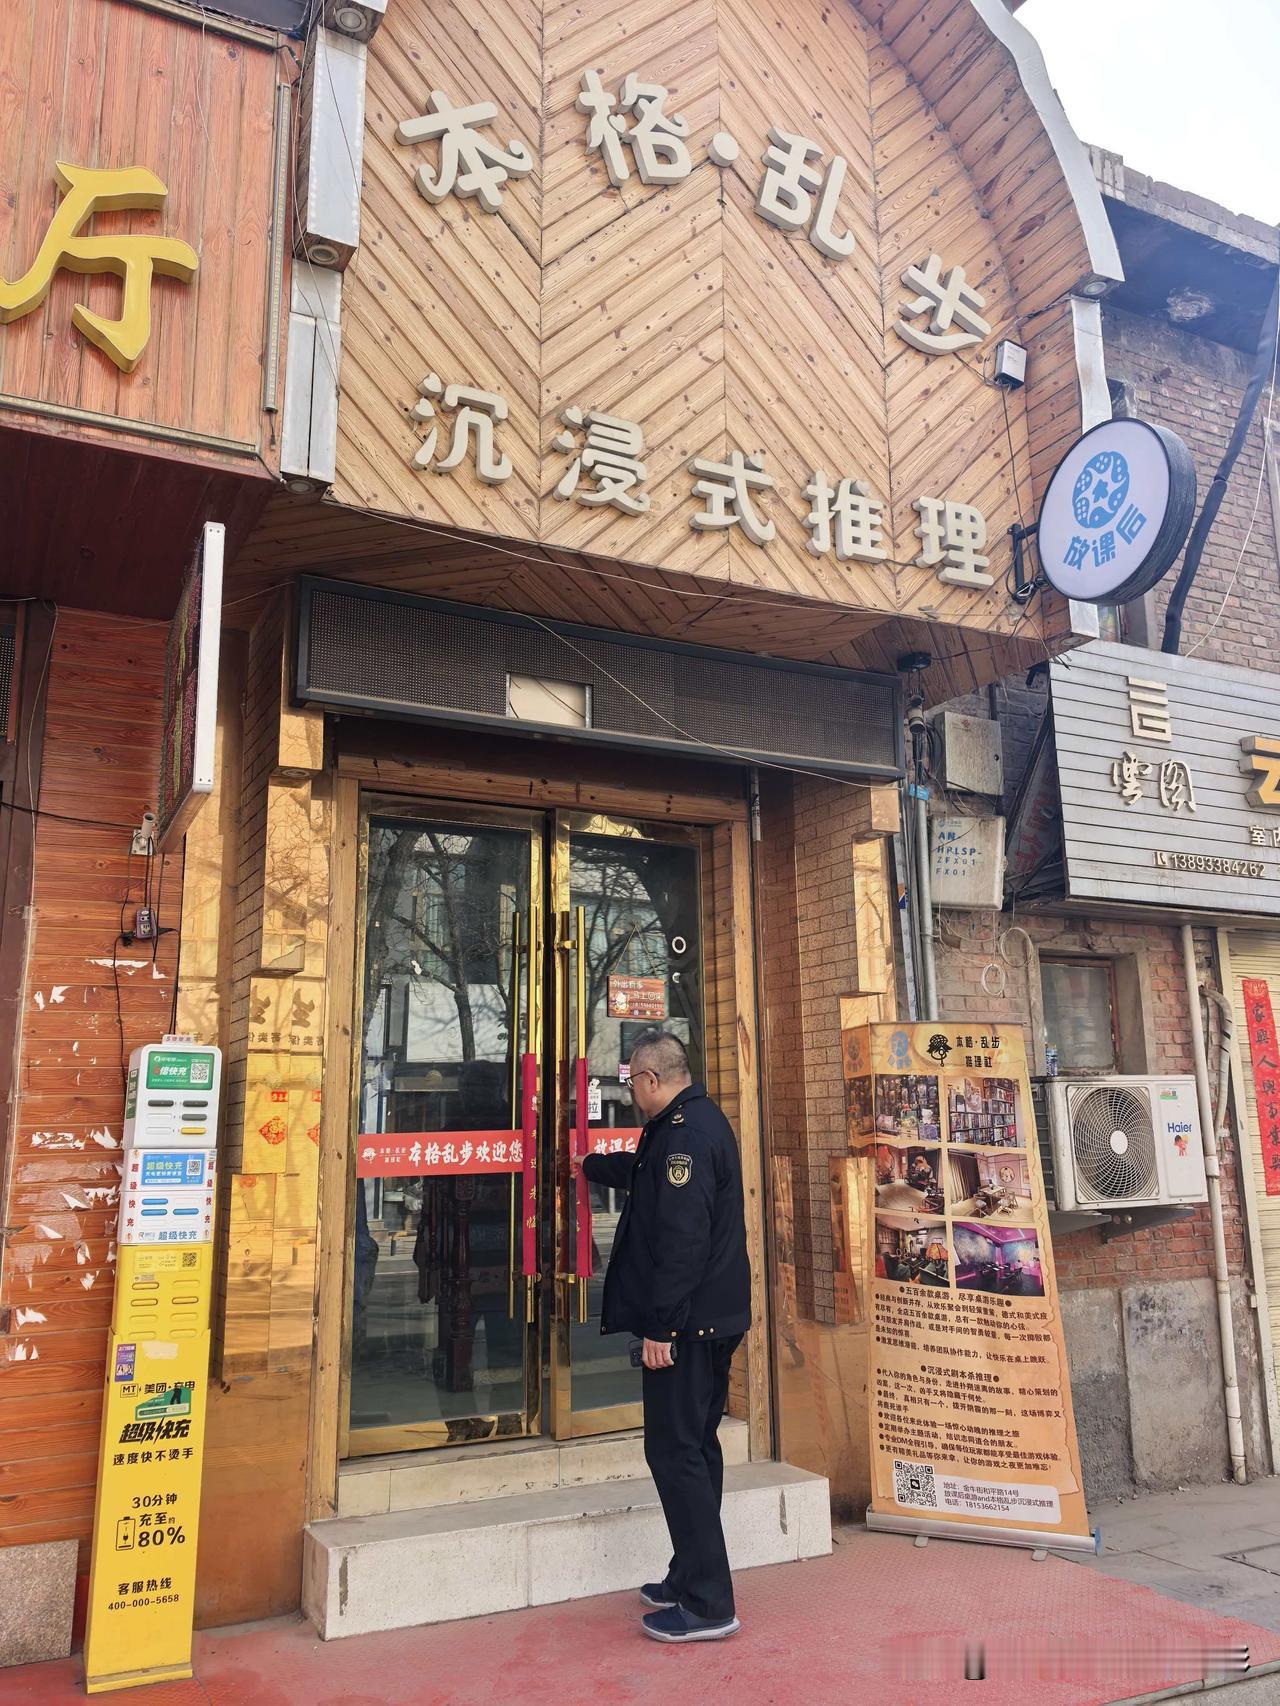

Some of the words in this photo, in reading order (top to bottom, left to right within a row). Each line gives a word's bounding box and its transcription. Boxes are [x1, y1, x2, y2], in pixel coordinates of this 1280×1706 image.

[410, 372, 993, 589] 沉浸式推理
[1063, 503, 1147, 571] 放课后
[938, 831, 956, 841] AN
[936, 867, 966, 876] FX01
[1171, 853, 1266, 878] 13893384262
[1167, 1121, 1192, 1134] Haier
[408, 1138, 524, 1168] 本格乱步欢迎您
[158, 1230, 198, 1240] 超级快充
[122, 1385, 137, 1393] MT
[119, 1418, 192, 1445] 超级快充
[113, 1447, 194, 1466] 速度快不烫手
[132, 1493, 178, 1509] 30分钟
[137, 1525, 186, 1548] 80%
[118, 1577, 173, 1595] 客服热线
[108, 1594, 180, 1611] 400-000-5658
